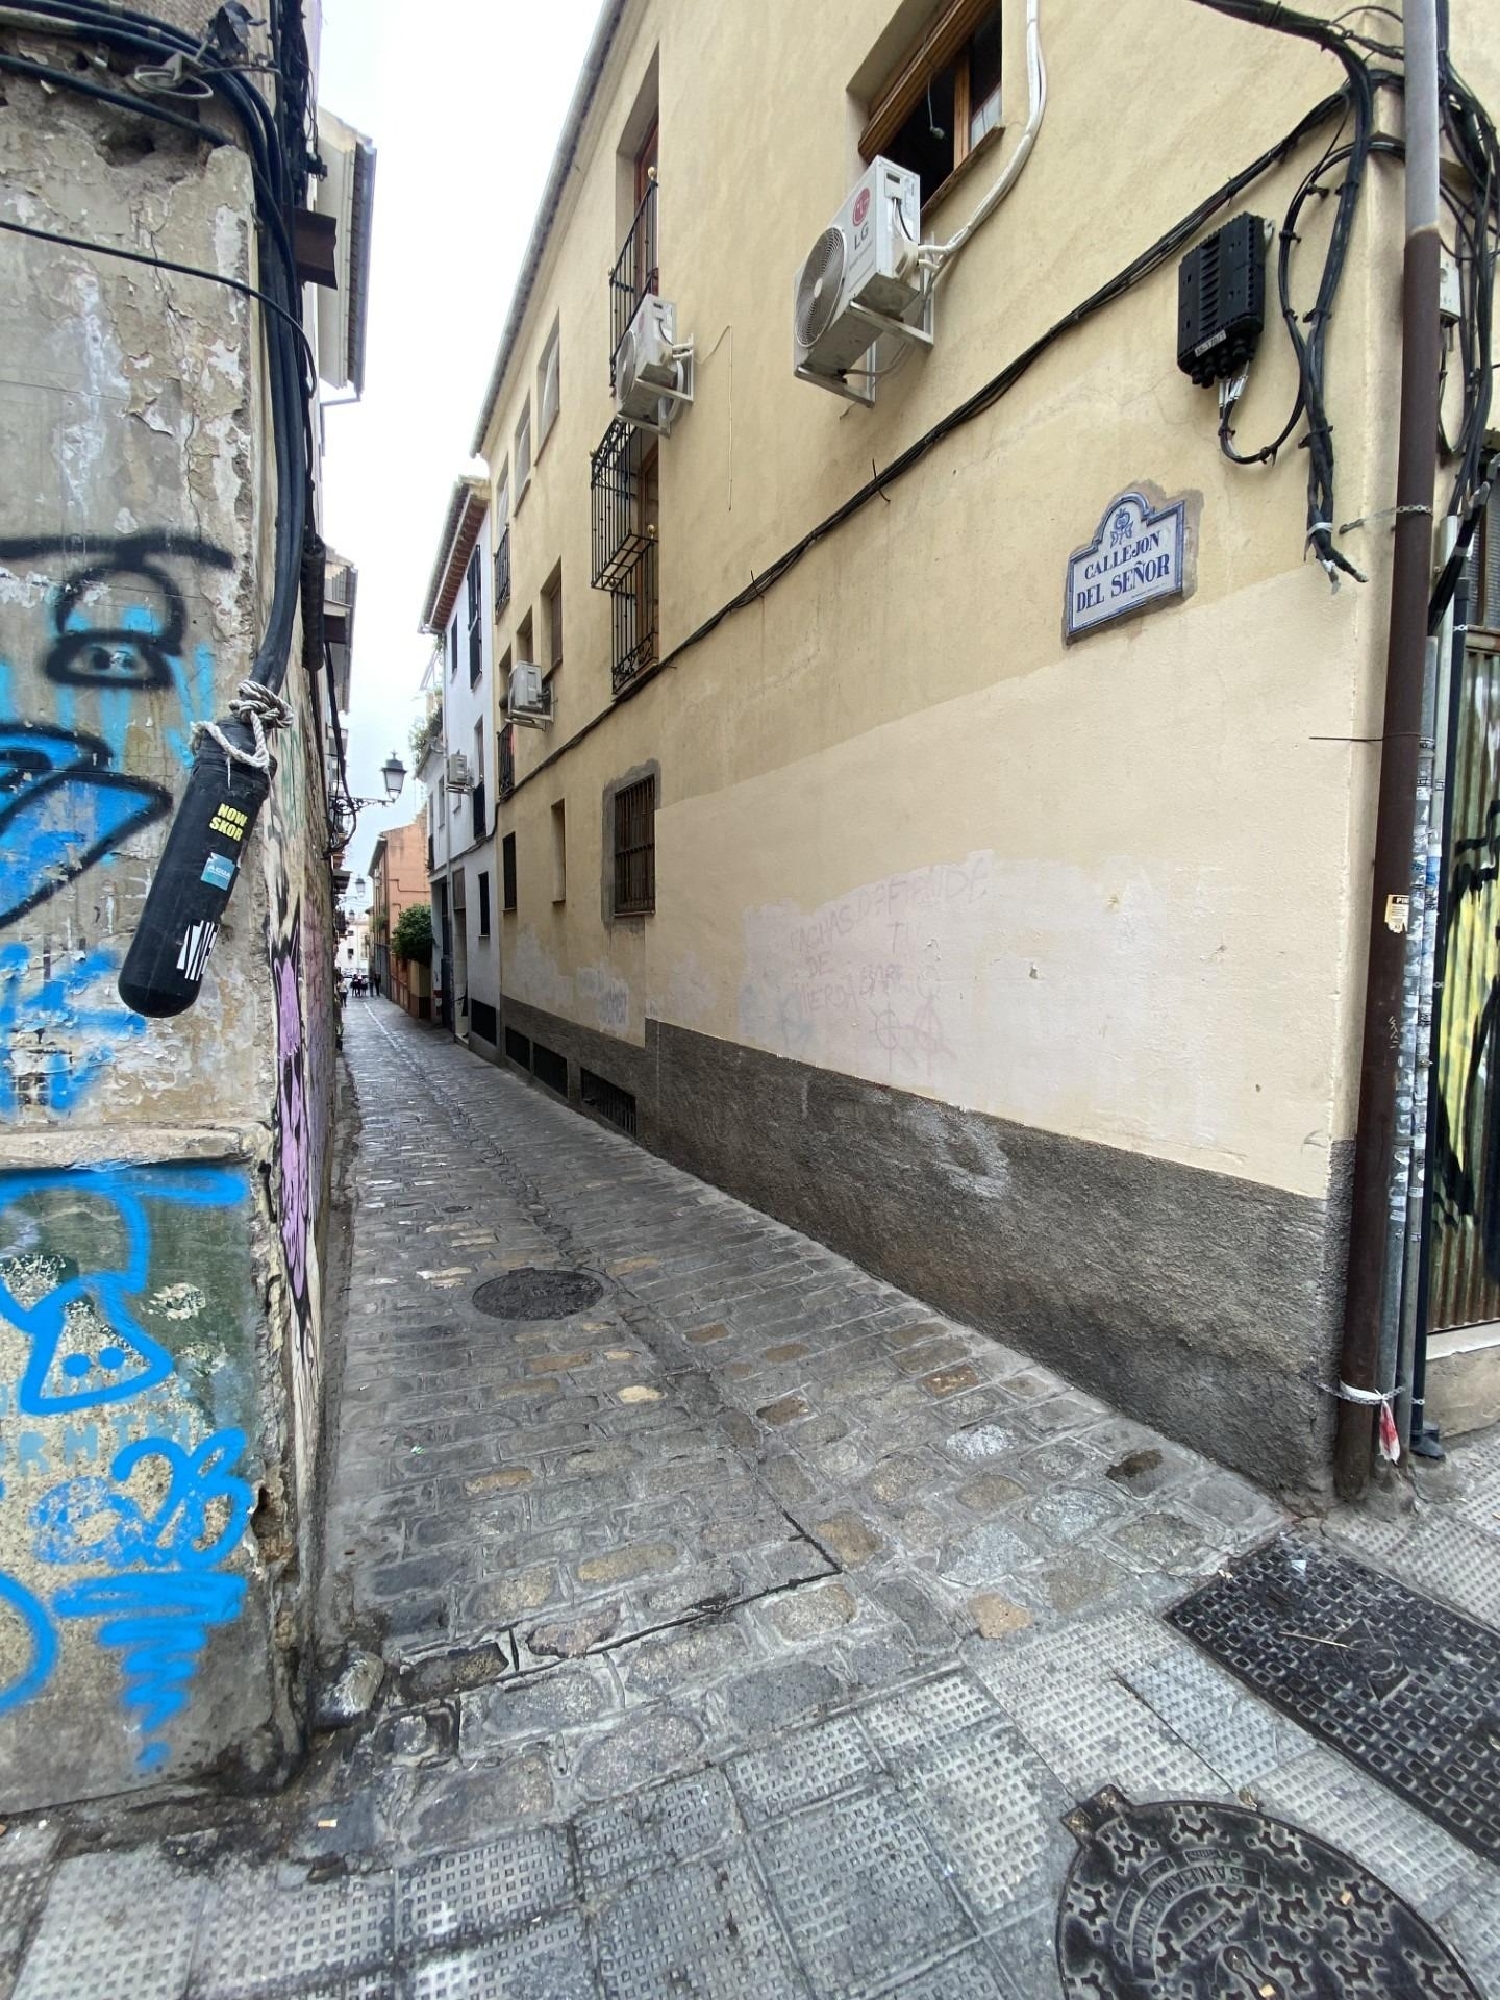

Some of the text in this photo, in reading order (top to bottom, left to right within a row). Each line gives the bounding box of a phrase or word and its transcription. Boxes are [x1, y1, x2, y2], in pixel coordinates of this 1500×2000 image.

[854, 224, 869, 250] LG
[1084, 530, 1160, 580] CALLEJON
[1076, 583, 1105, 613] DEL
[1110, 553, 1170, 598] SEÑOR
[217, 802, 248, 827] NOW
[1132, 1866, 1243, 1960] SANEAMIENTO
